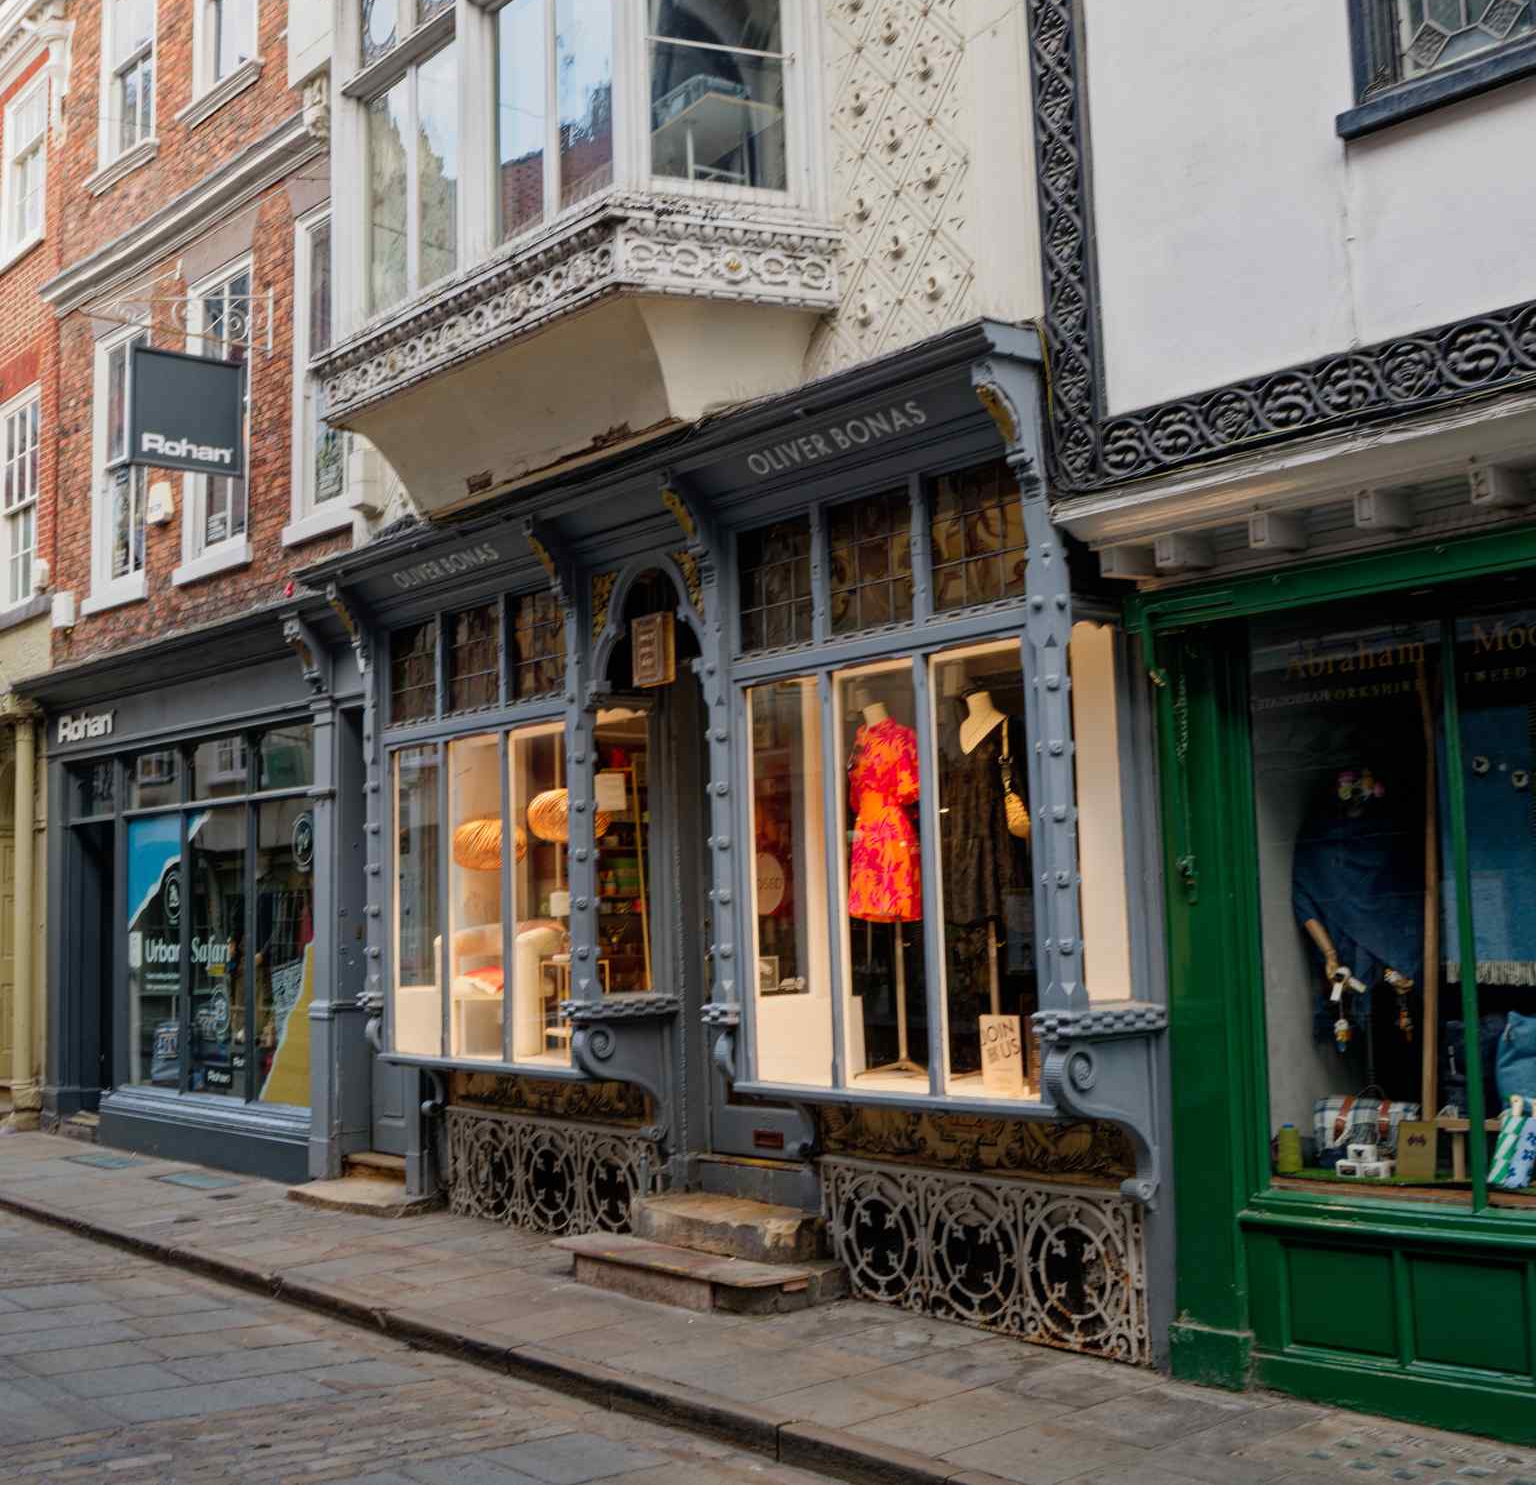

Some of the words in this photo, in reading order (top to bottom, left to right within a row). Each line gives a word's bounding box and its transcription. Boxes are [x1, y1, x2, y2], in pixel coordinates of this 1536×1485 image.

[141, 431, 233, 464] Rohan
[747, 433, 833, 475] OLIVER
[828, 400, 927, 450] BONAS
[392, 560, 445, 588] OLIVER
[439, 543, 499, 574] BONAS
[1284, 641, 1424, 681] Abraham
[57, 710, 113, 744] Rohan
[190, 935, 232, 964] Safari
